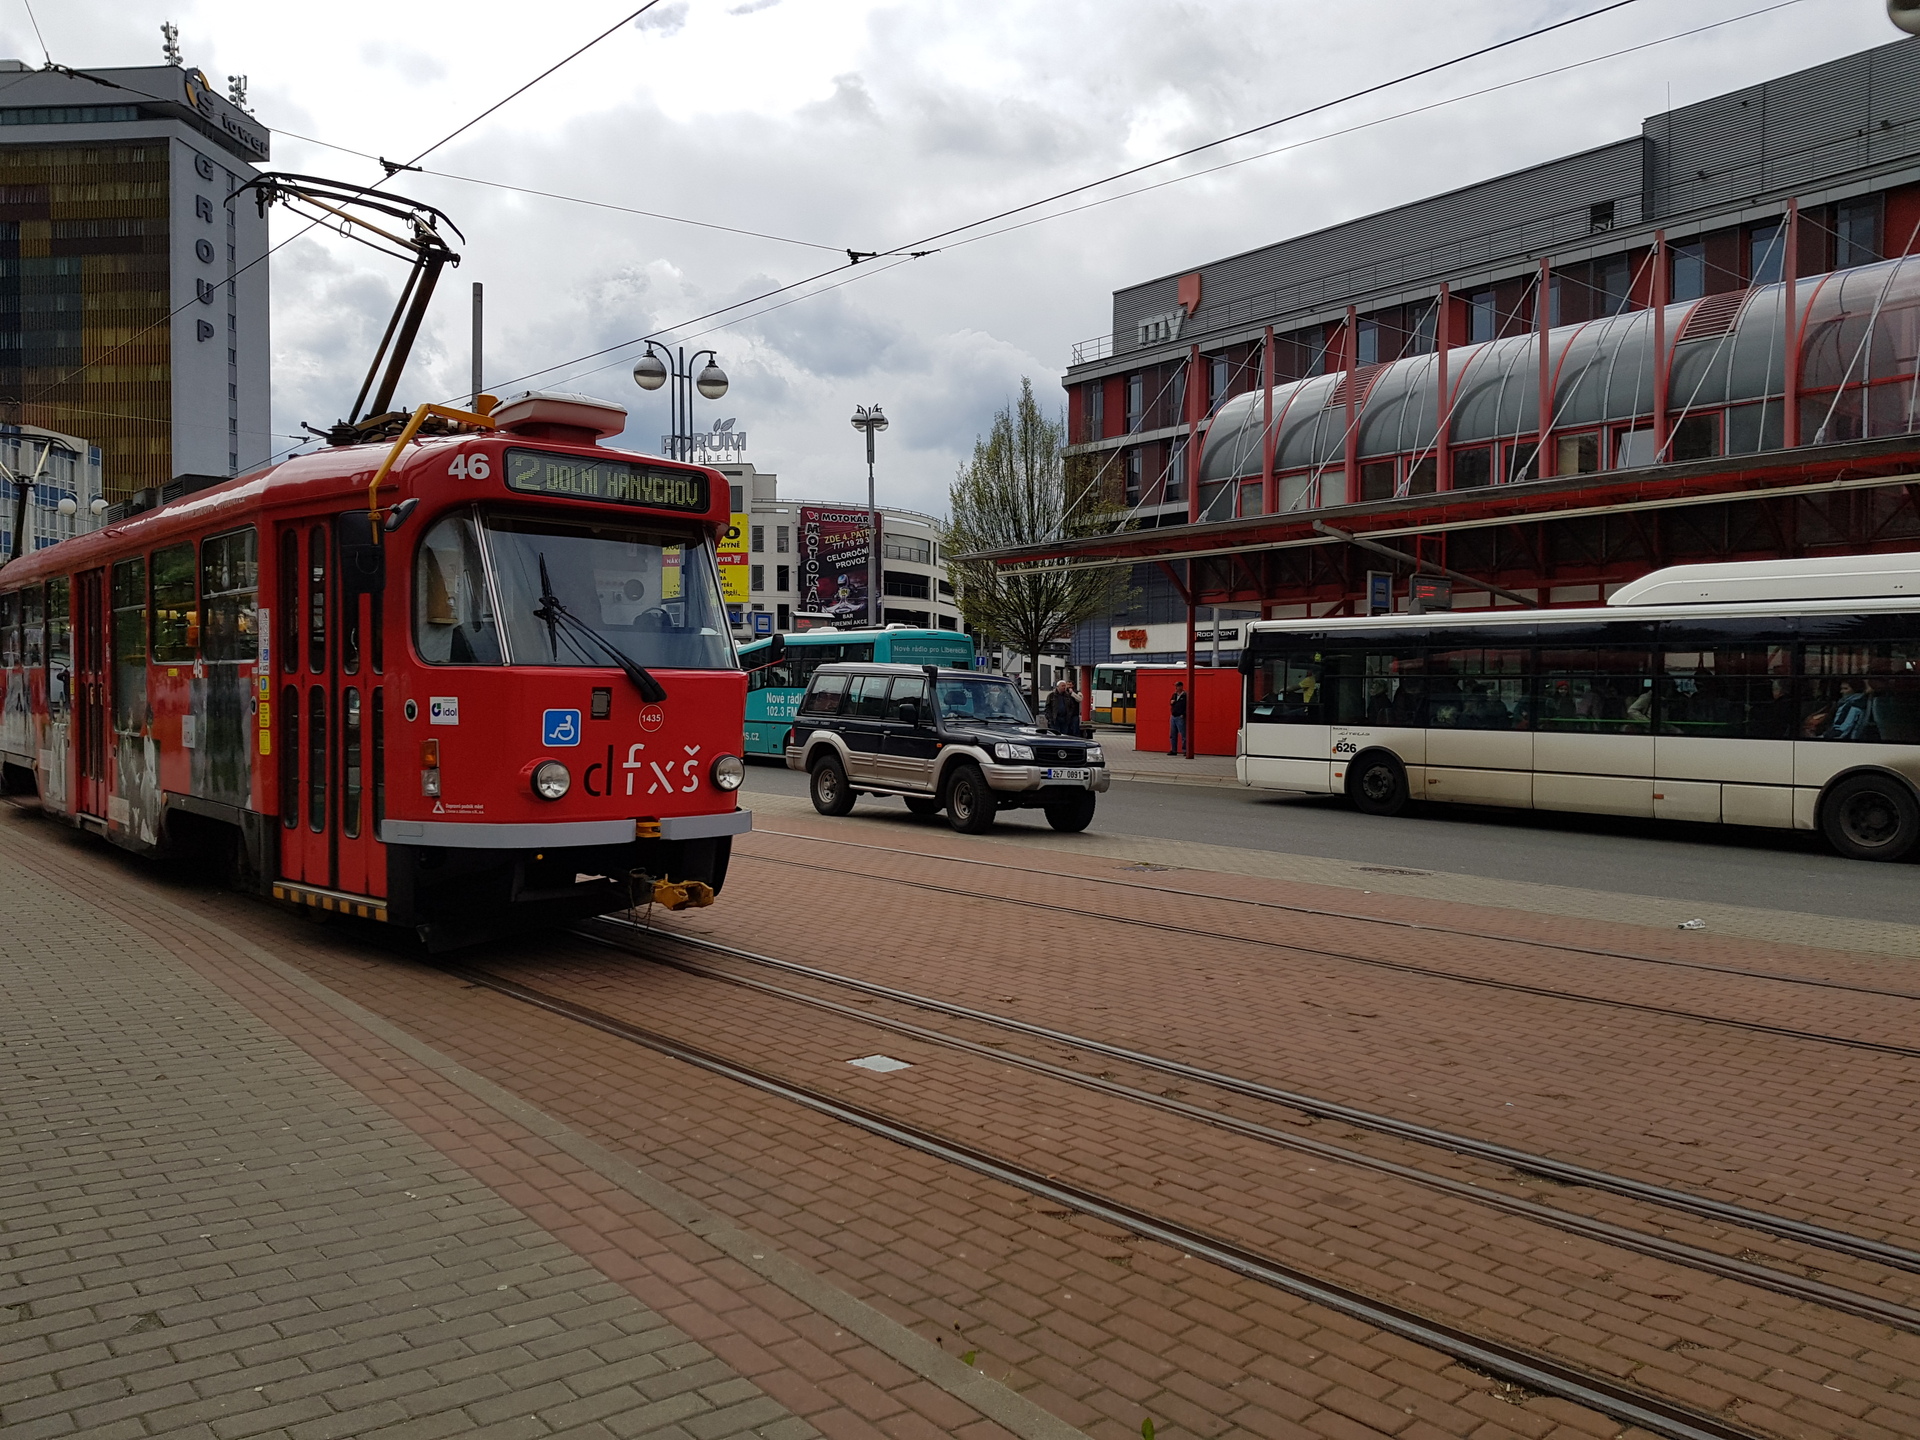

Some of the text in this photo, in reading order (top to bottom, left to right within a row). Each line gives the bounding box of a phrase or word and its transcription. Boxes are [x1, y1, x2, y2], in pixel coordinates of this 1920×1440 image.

[194, 152, 215, 342] GROUP
[448, 453, 490, 479] 46
[515, 455, 541, 490] 2
[607, 471, 698, 506] HANYCHOV
[821, 513, 876, 523] MOTOKÁR
[824, 534, 841, 544] ZDE
[842, 533, 851, 541] 4.
[832, 542, 845, 550] 777
[826, 546, 869, 562] CELOROČNÍ
[835, 556, 866, 569] PROVOZ
[940, 646, 968, 654] Liberecko
[193, 658, 203, 679] 46
[766, 692, 785, 704] Nové
[443, 708, 457, 717] idol
[766, 706, 799, 717] 102.3 FM
[642, 714, 662, 723] 1435
[1336, 742, 1357, 753] 626
